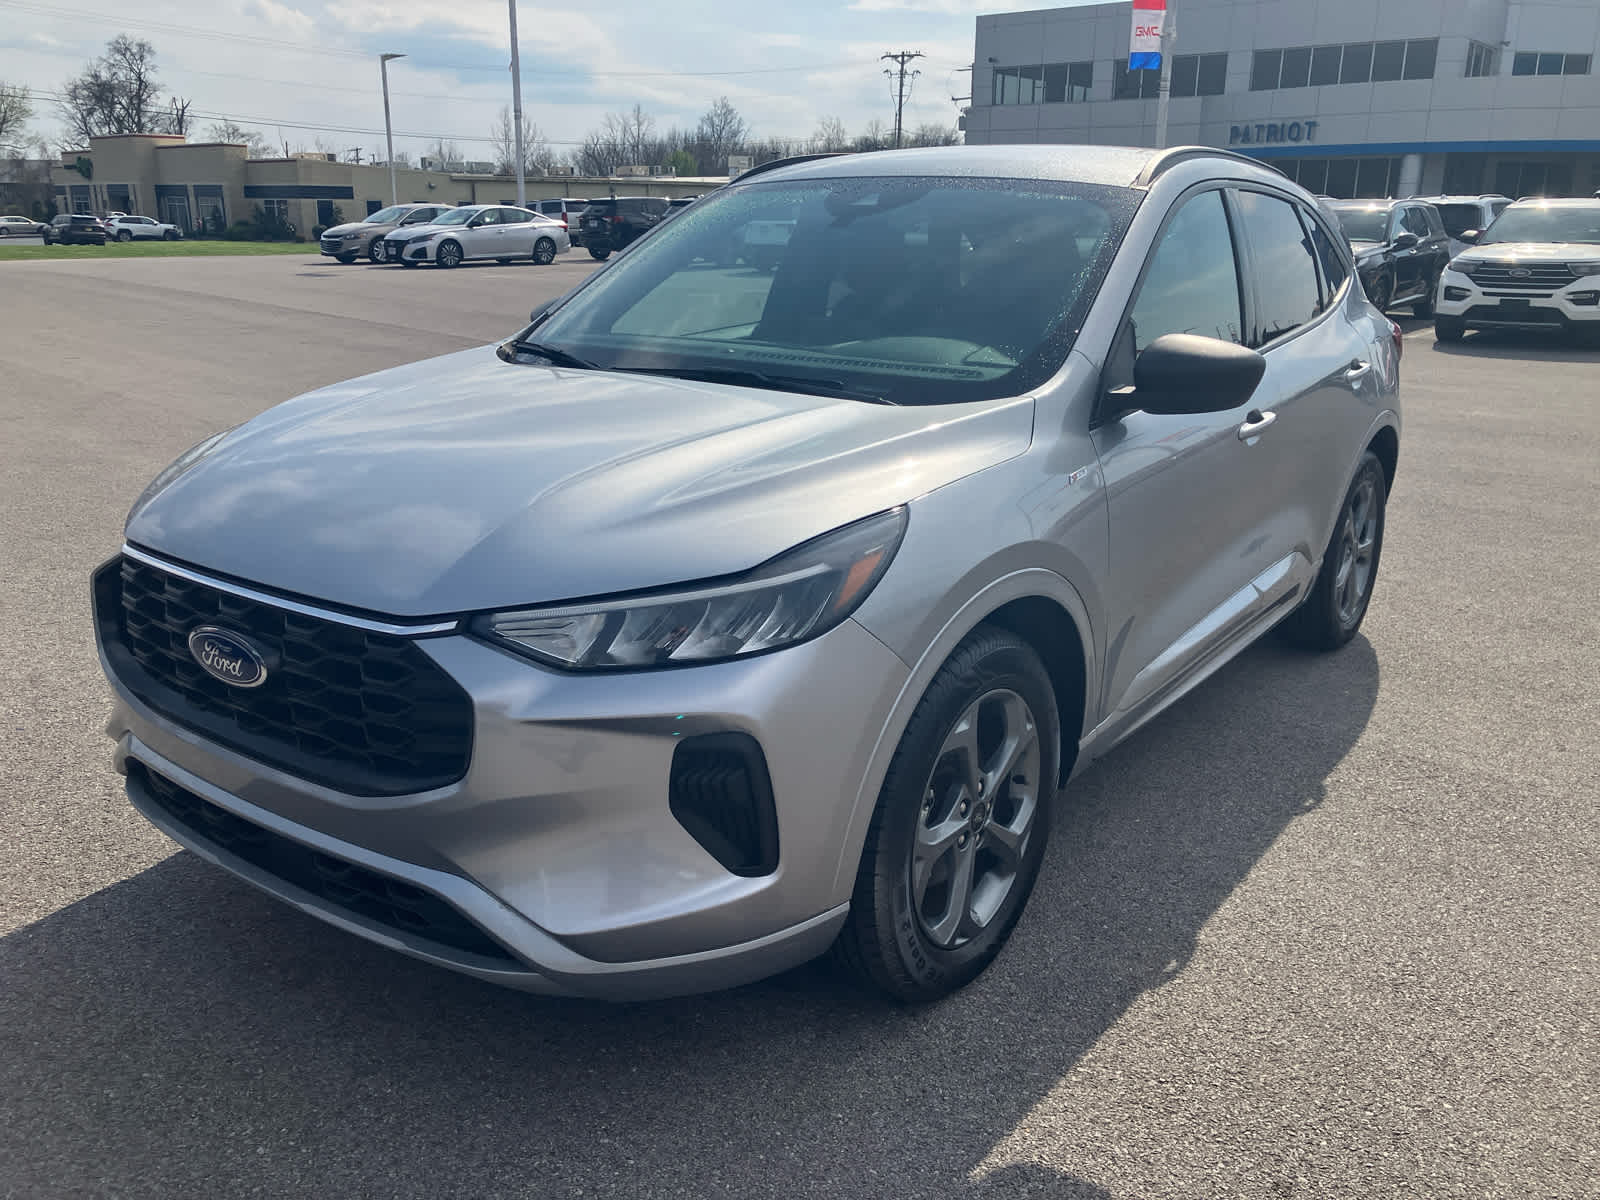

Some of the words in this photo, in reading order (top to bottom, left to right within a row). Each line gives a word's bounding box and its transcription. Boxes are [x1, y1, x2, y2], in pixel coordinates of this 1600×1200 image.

[1135, 25, 1160, 37] GMC
[1229, 121, 1318, 145] PATRIOT
[201, 640, 243, 677] Ford
